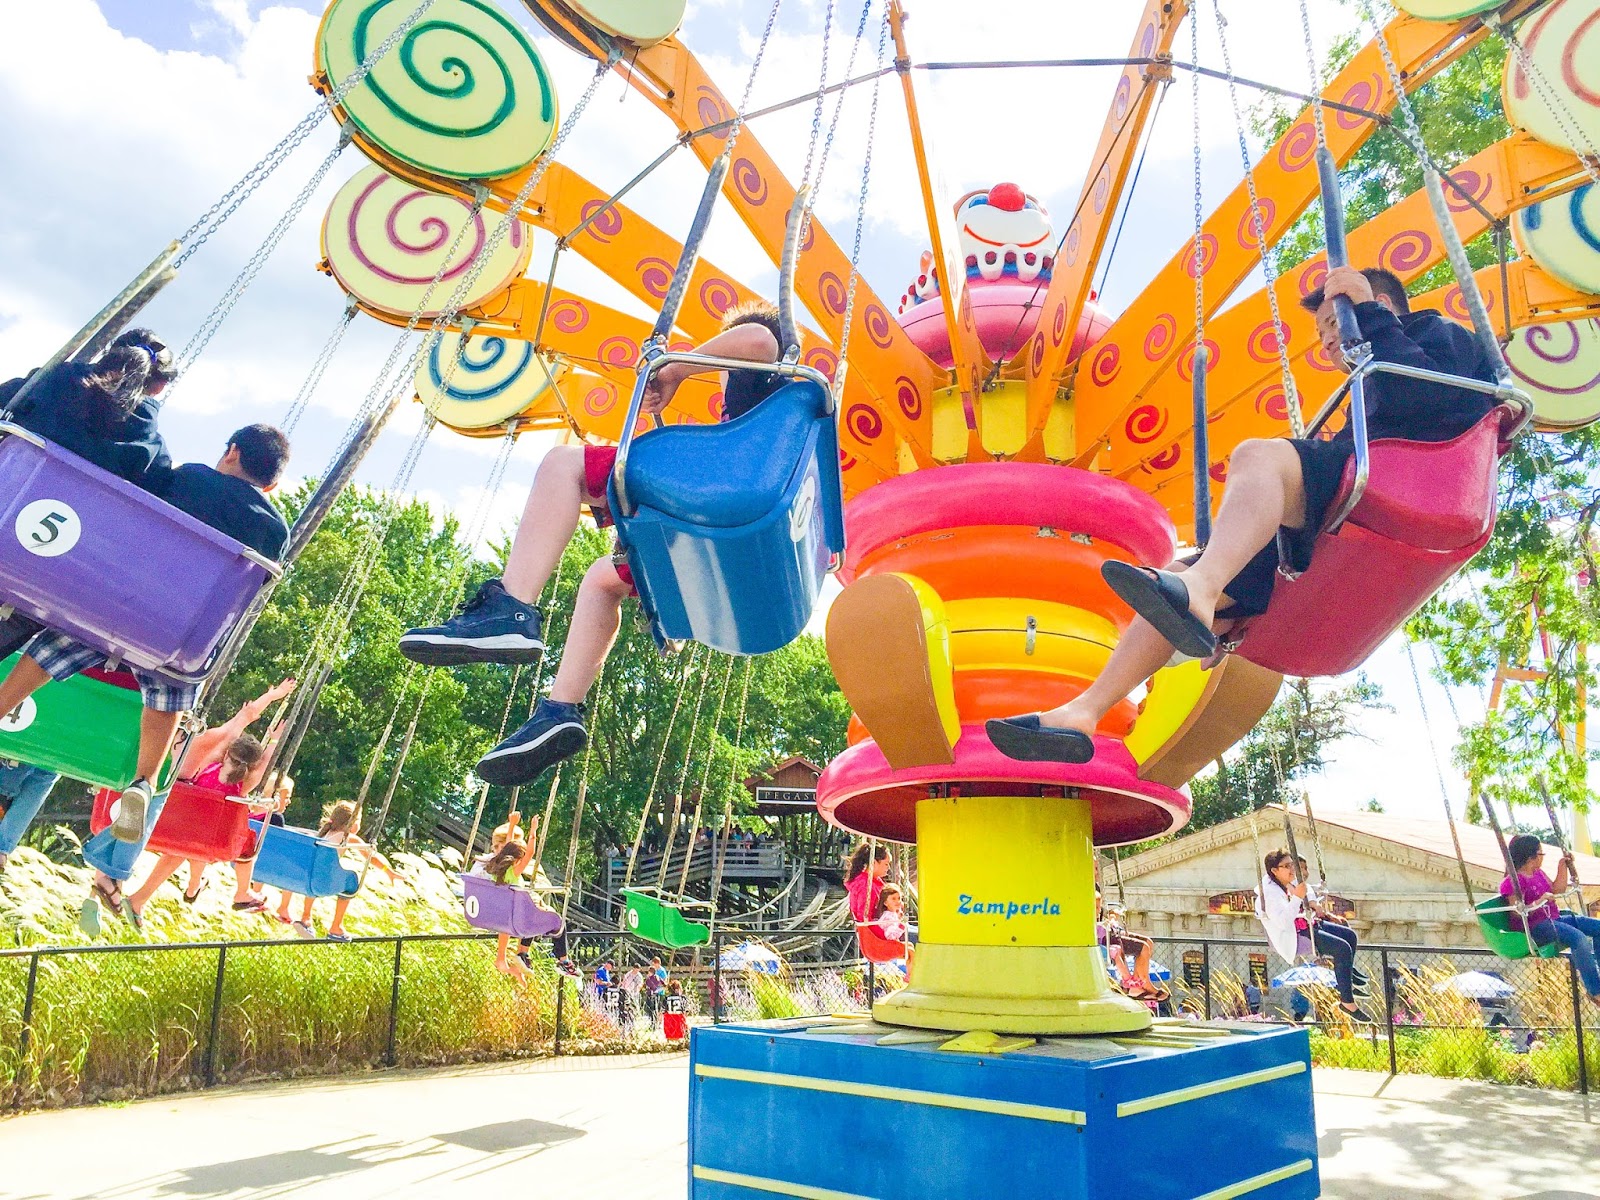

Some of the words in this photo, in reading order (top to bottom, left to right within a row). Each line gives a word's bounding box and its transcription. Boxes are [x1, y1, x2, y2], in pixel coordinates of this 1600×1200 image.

[31, 511, 68, 544] 5
[6, 701, 25, 724] 4
[957, 893, 1061, 920] Zamperla
[668, 999, 682, 1014] 12
